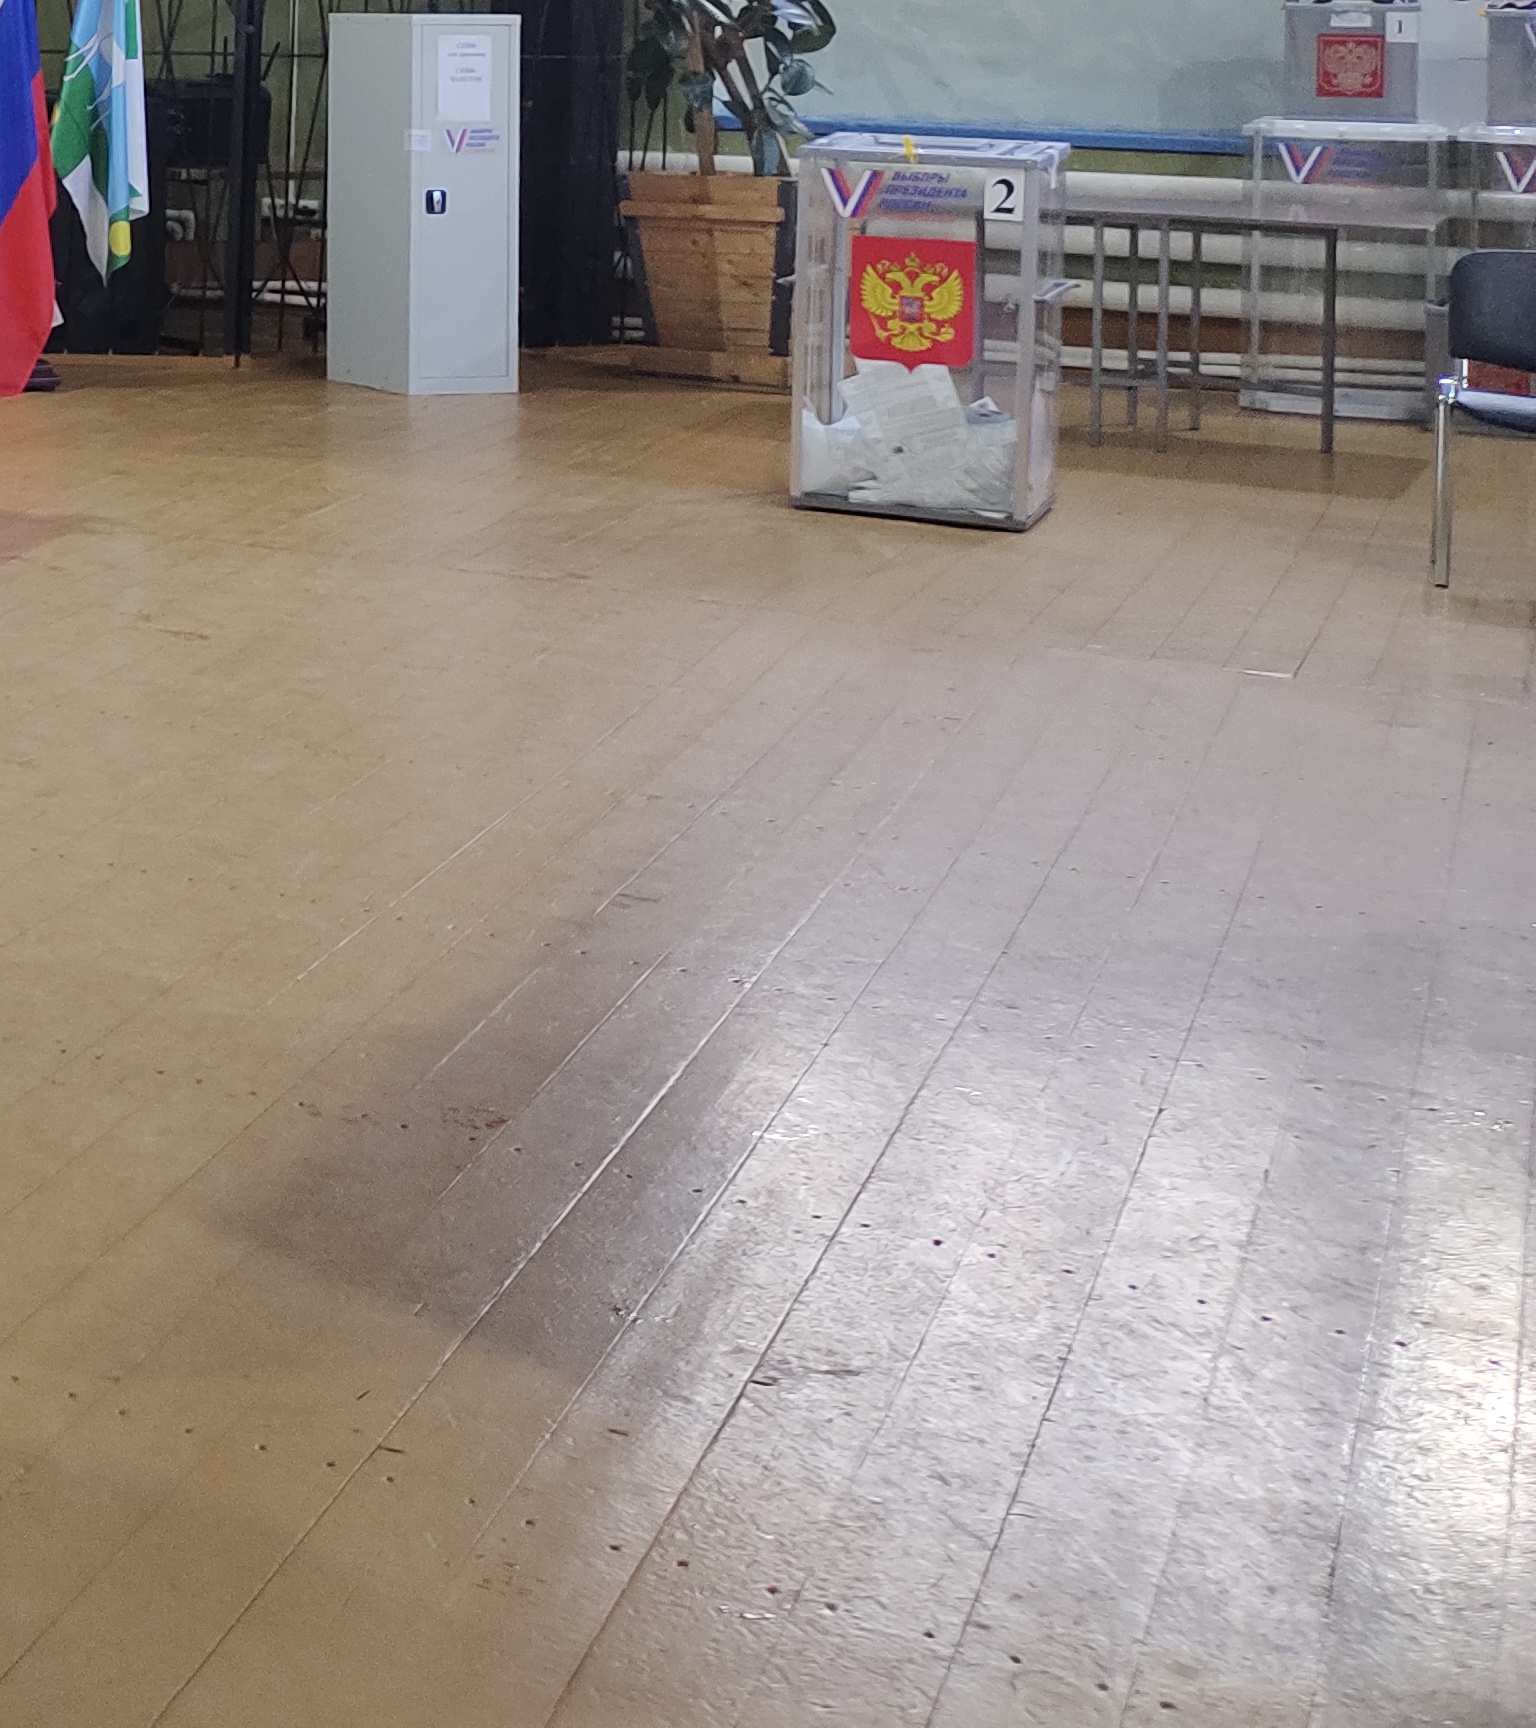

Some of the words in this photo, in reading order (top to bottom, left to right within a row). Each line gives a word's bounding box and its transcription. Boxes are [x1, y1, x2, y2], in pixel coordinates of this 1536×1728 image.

[891, 171, 950, 184] ВЫБОРЫ
[883, 184, 968, 200] ПРЕЗИДЕНТА
[991, 178, 1016, 215] 2
